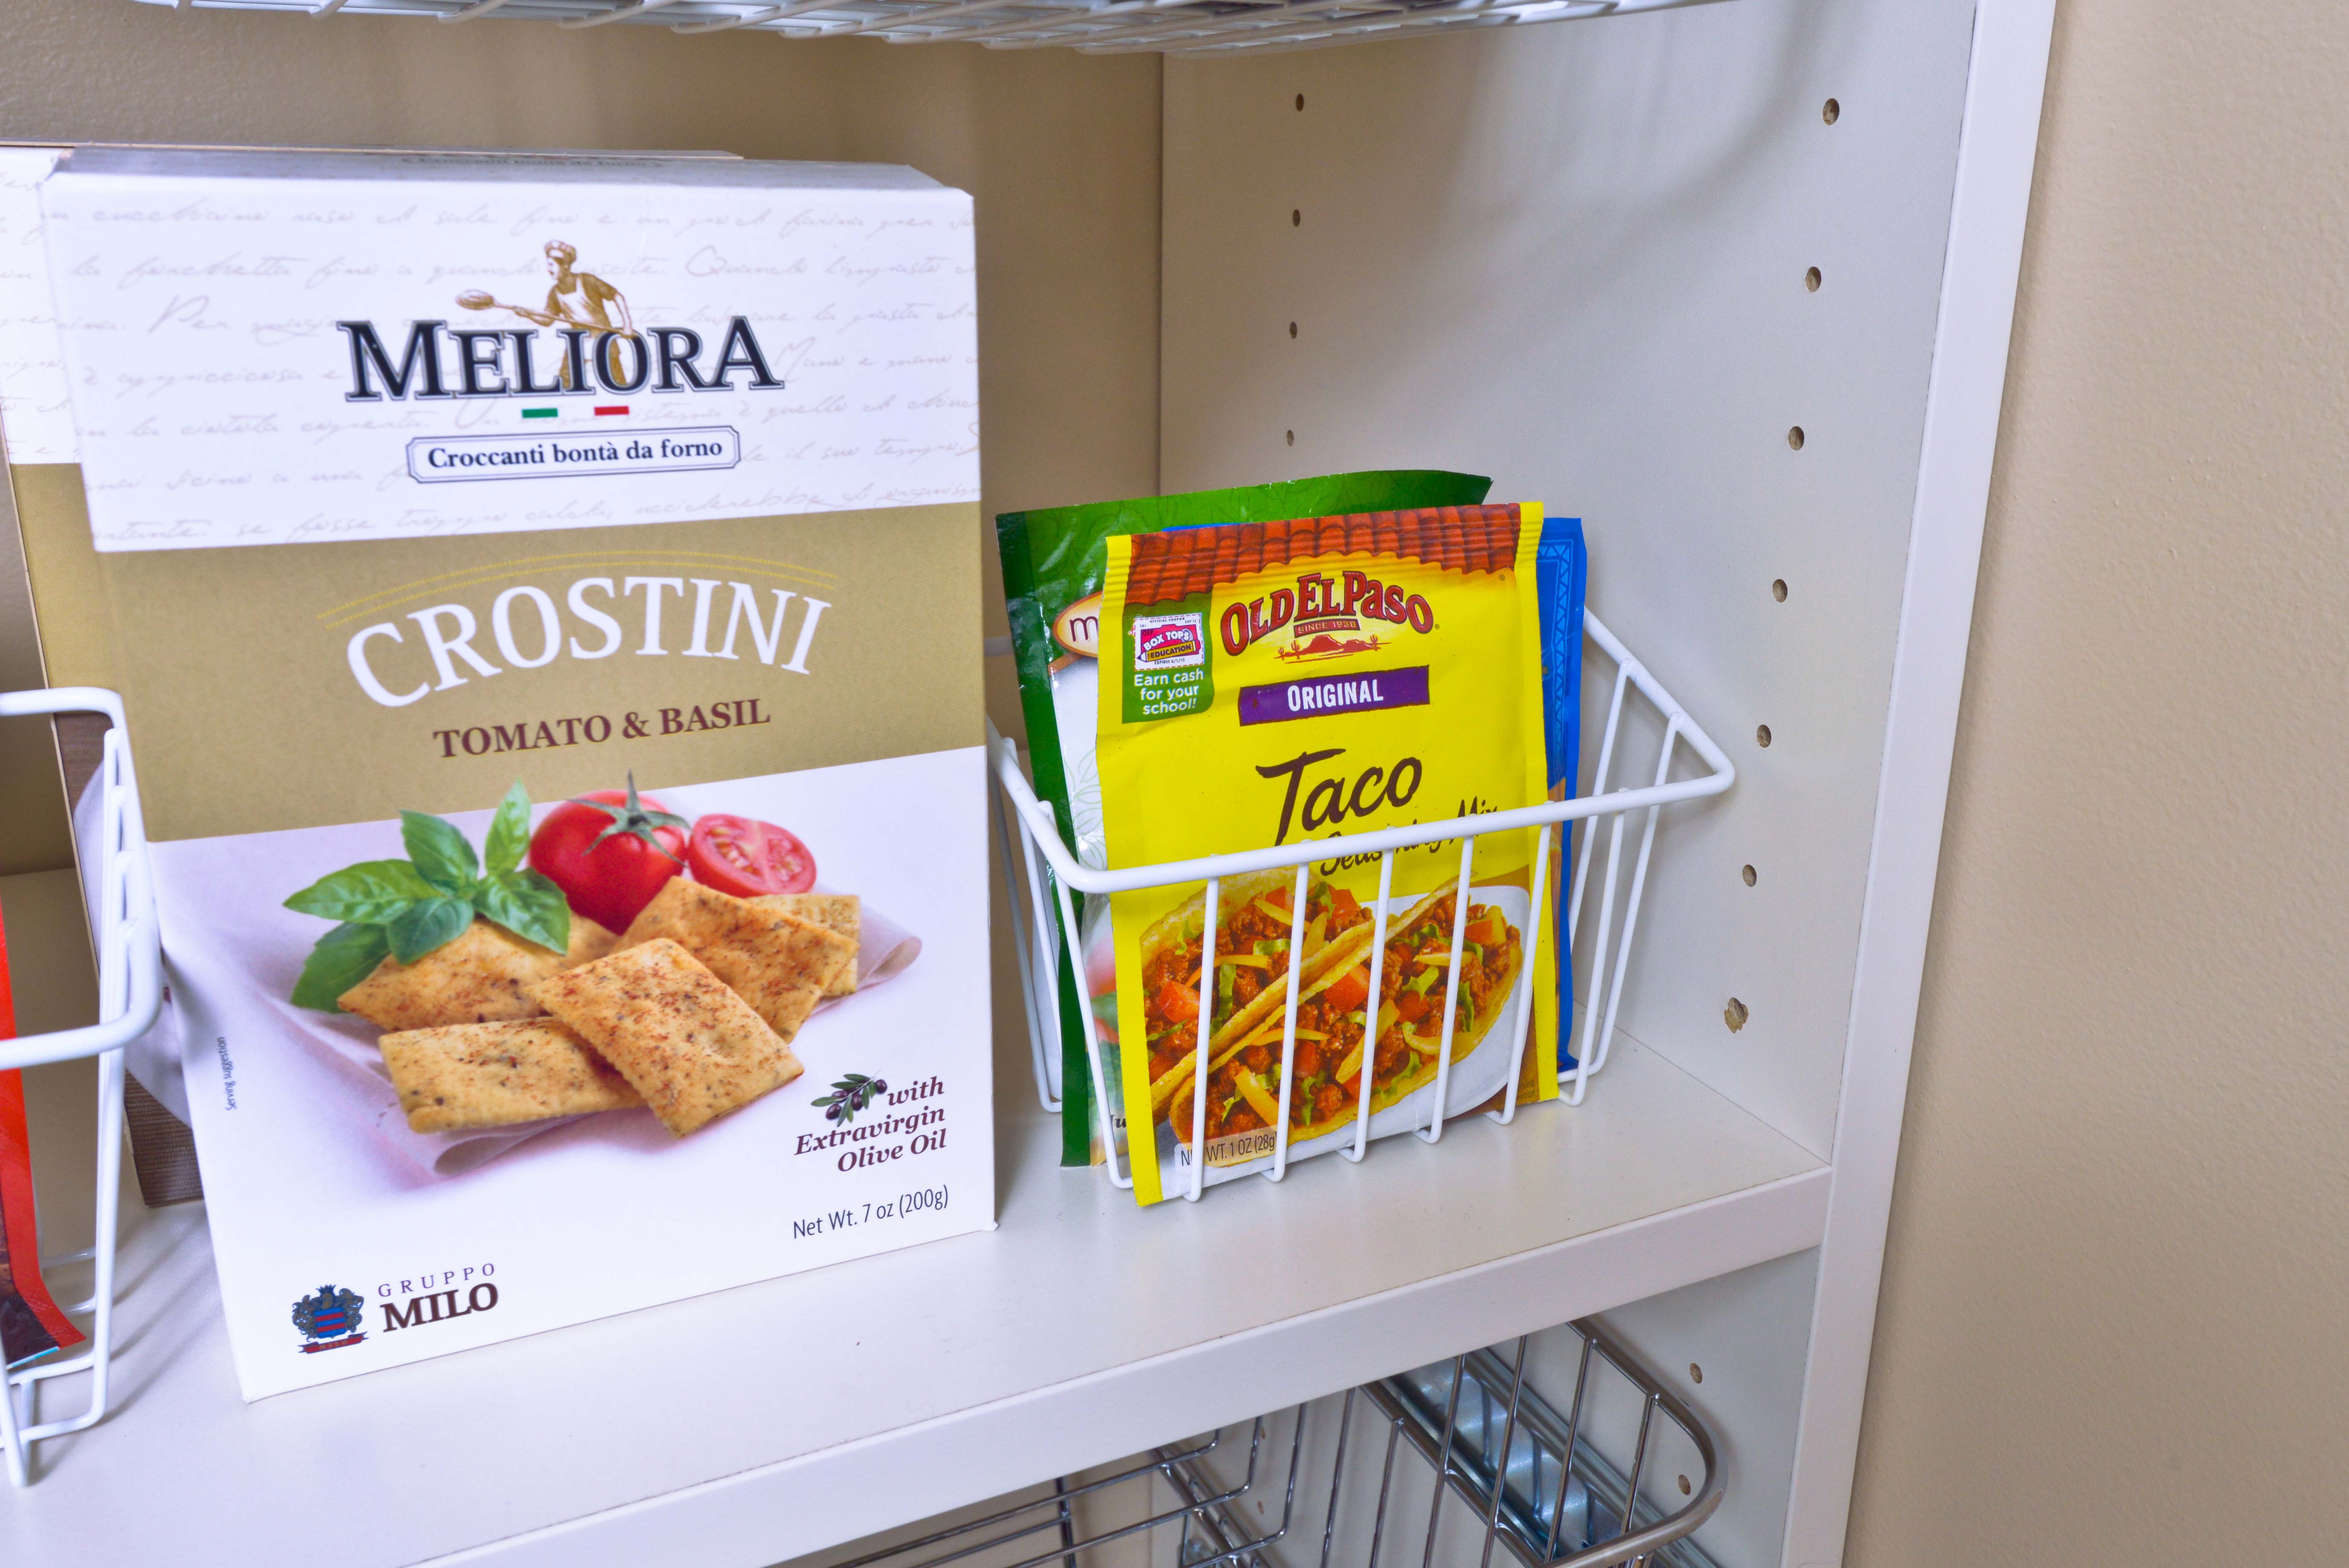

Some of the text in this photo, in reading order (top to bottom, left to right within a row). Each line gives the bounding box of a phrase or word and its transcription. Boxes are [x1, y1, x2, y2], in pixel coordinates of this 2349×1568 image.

[336, 316, 785, 401] MELIORA
[428, 443, 545, 469] Croccanti
[552, 441, 620, 464] bontà
[626, 439, 654, 460] da
[660, 438, 723, 458] forno
[1220, 588, 1294, 656] OLD
[1294, 572, 1340, 622] EL
[1298, 623, 1327, 634] SINCE
[347, 576, 831, 707] CROSTINI
[1143, 634, 1164, 651] BOX
[1150, 644, 1191, 658] EDUCATION
[1134, 668, 1204, 687] Earn cash
[1140, 685, 1199, 701] for your
[1143, 698, 1197, 715] school!
[1287, 679, 1383, 712] ORIGINAL
[432, 698, 771, 757] TOMATO & BASIL
[1255, 748, 1422, 846] Taco
[217, 1037, 237, 1110] Serving suggestion
[887, 1076, 944, 1106] with
[794, 1105, 945, 1155] Extravirgin
[837, 1128, 947, 1172] Olive Oil
[1206, 1142, 1227, 1162] WT.
[1230, 1141, 1235, 1157] 1
[1238, 1138, 1252, 1155] OZ
[794, 1185, 949, 1239] Net Wt. 7 oz (200g)
[378, 1263, 495, 1297] GRUPPO
[379, 1283, 498, 1333] MILO
